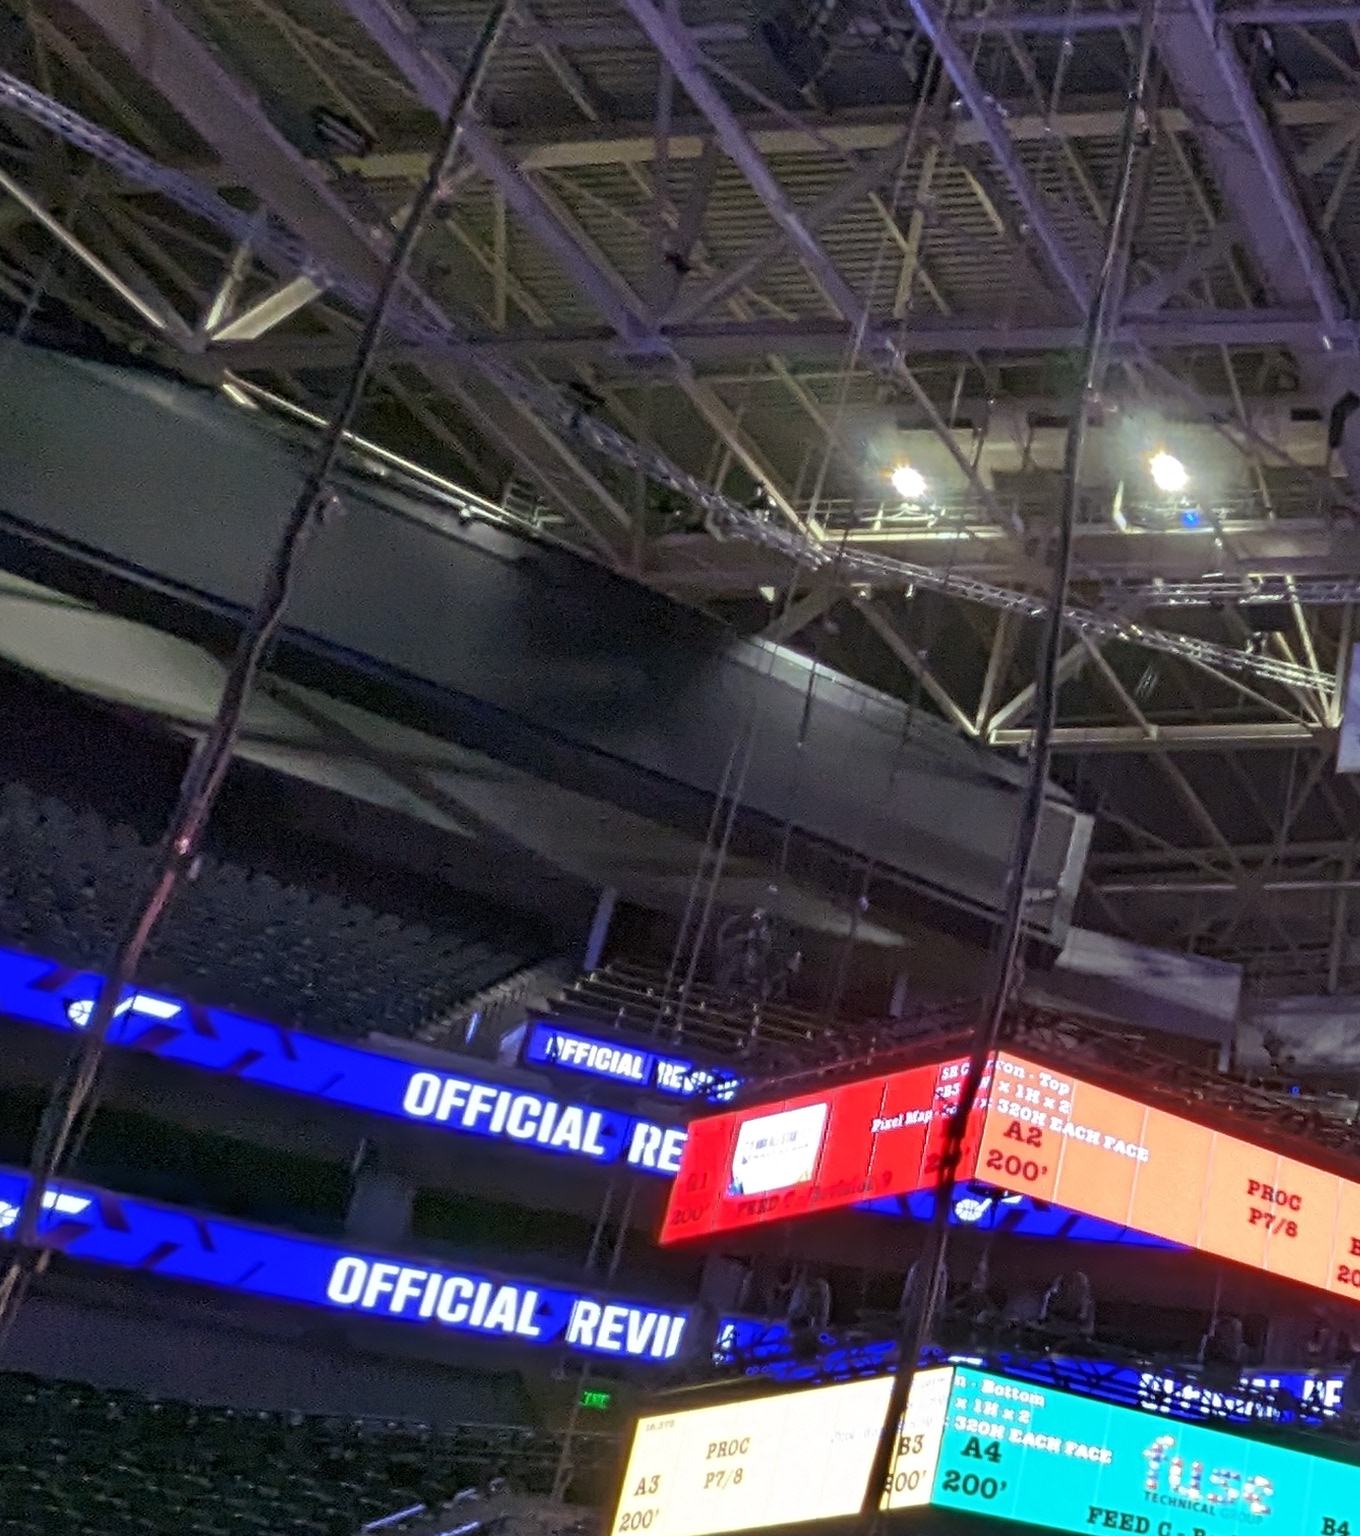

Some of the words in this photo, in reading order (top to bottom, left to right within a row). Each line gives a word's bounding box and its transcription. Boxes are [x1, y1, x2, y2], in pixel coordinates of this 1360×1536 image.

[403, 1070, 607, 1158] OFFICIAL
[871, 1115, 902, 1132] Pixel
[905, 1109, 932, 1126] Map
[997, 1099, 1046, 1127] 320H
[1049, 1116, 1100, 1144] EACH
[1102, 1134, 1150, 1162] FACE
[1003, 1121, 1044, 1147] A2
[986, 1149, 1048, 1181] 200'
[1247, 1178, 1302, 1211] PROC
[1248, 1208, 1298, 1238] P7/8
[326, 1254, 544, 1339] OFFICIAL
[980, 1378, 1046, 1408] Bottom
[706, 1437, 750, 1460] PROC
[954, 1416, 1006, 1440] 320H
[1008, 1426, 1061, 1454] EACH
[1064, 1440, 1112, 1464] FACE
[960, 1436, 1002, 1464] A4
[633, 1475, 661, 1497] A3
[703, 1468, 743, 1489] P7/8
[942, 1470, 1007, 1500] 200'
[1144, 1491, 1216, 1517] TECHNICAL
[619, 1509, 660, 1532] 200'
[1086, 1506, 1150, 1534] FEED
